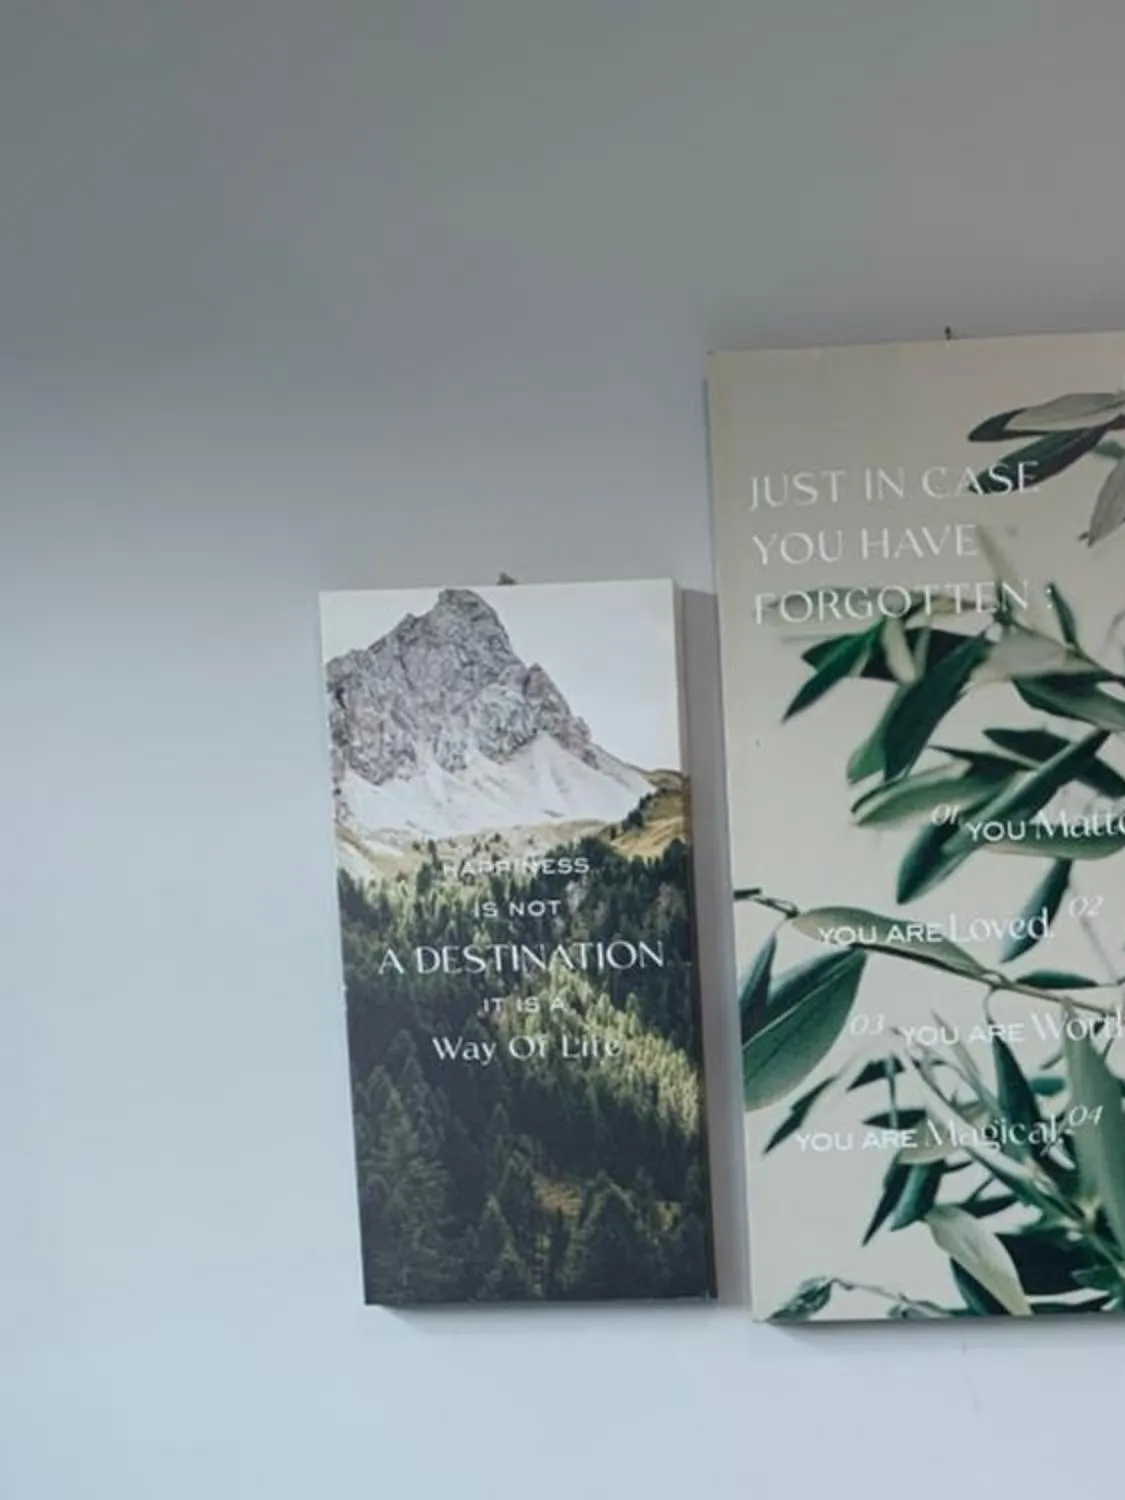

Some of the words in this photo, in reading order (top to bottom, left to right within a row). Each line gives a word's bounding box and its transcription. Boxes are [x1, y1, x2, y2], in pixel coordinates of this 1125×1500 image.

[749, 471, 845, 512] JUST
[864, 467, 903, 499] IN
[921, 461, 1040, 499] CASE
[752, 530, 843, 565] YOU
[862, 524, 978, 558] HAVE
[967, 819, 1026, 843] YOU
[443, 856, 589, 879] HAPPINESS
[474, 902, 498, 918] IS
[509, 900, 561, 918] NOT
[818, 925, 877, 947] YOU
[886, 922, 943, 943] ARE
[379, 948, 405, 975] A
[417, 940, 664, 974] DESTINATION
[483, 997, 502, 1013] IT
[517, 997, 540, 1013] IS
[550, 997, 568, 1012] A
[898, 1025, 959, 1047] YOU
[967, 1023, 1026, 1043] ARE
[432, 1036, 496, 1067] Way
[562, 1036, 622, 1060] Life
[795, 1131, 853, 1153] YOU
[862, 1128, 917, 1149] ARE
